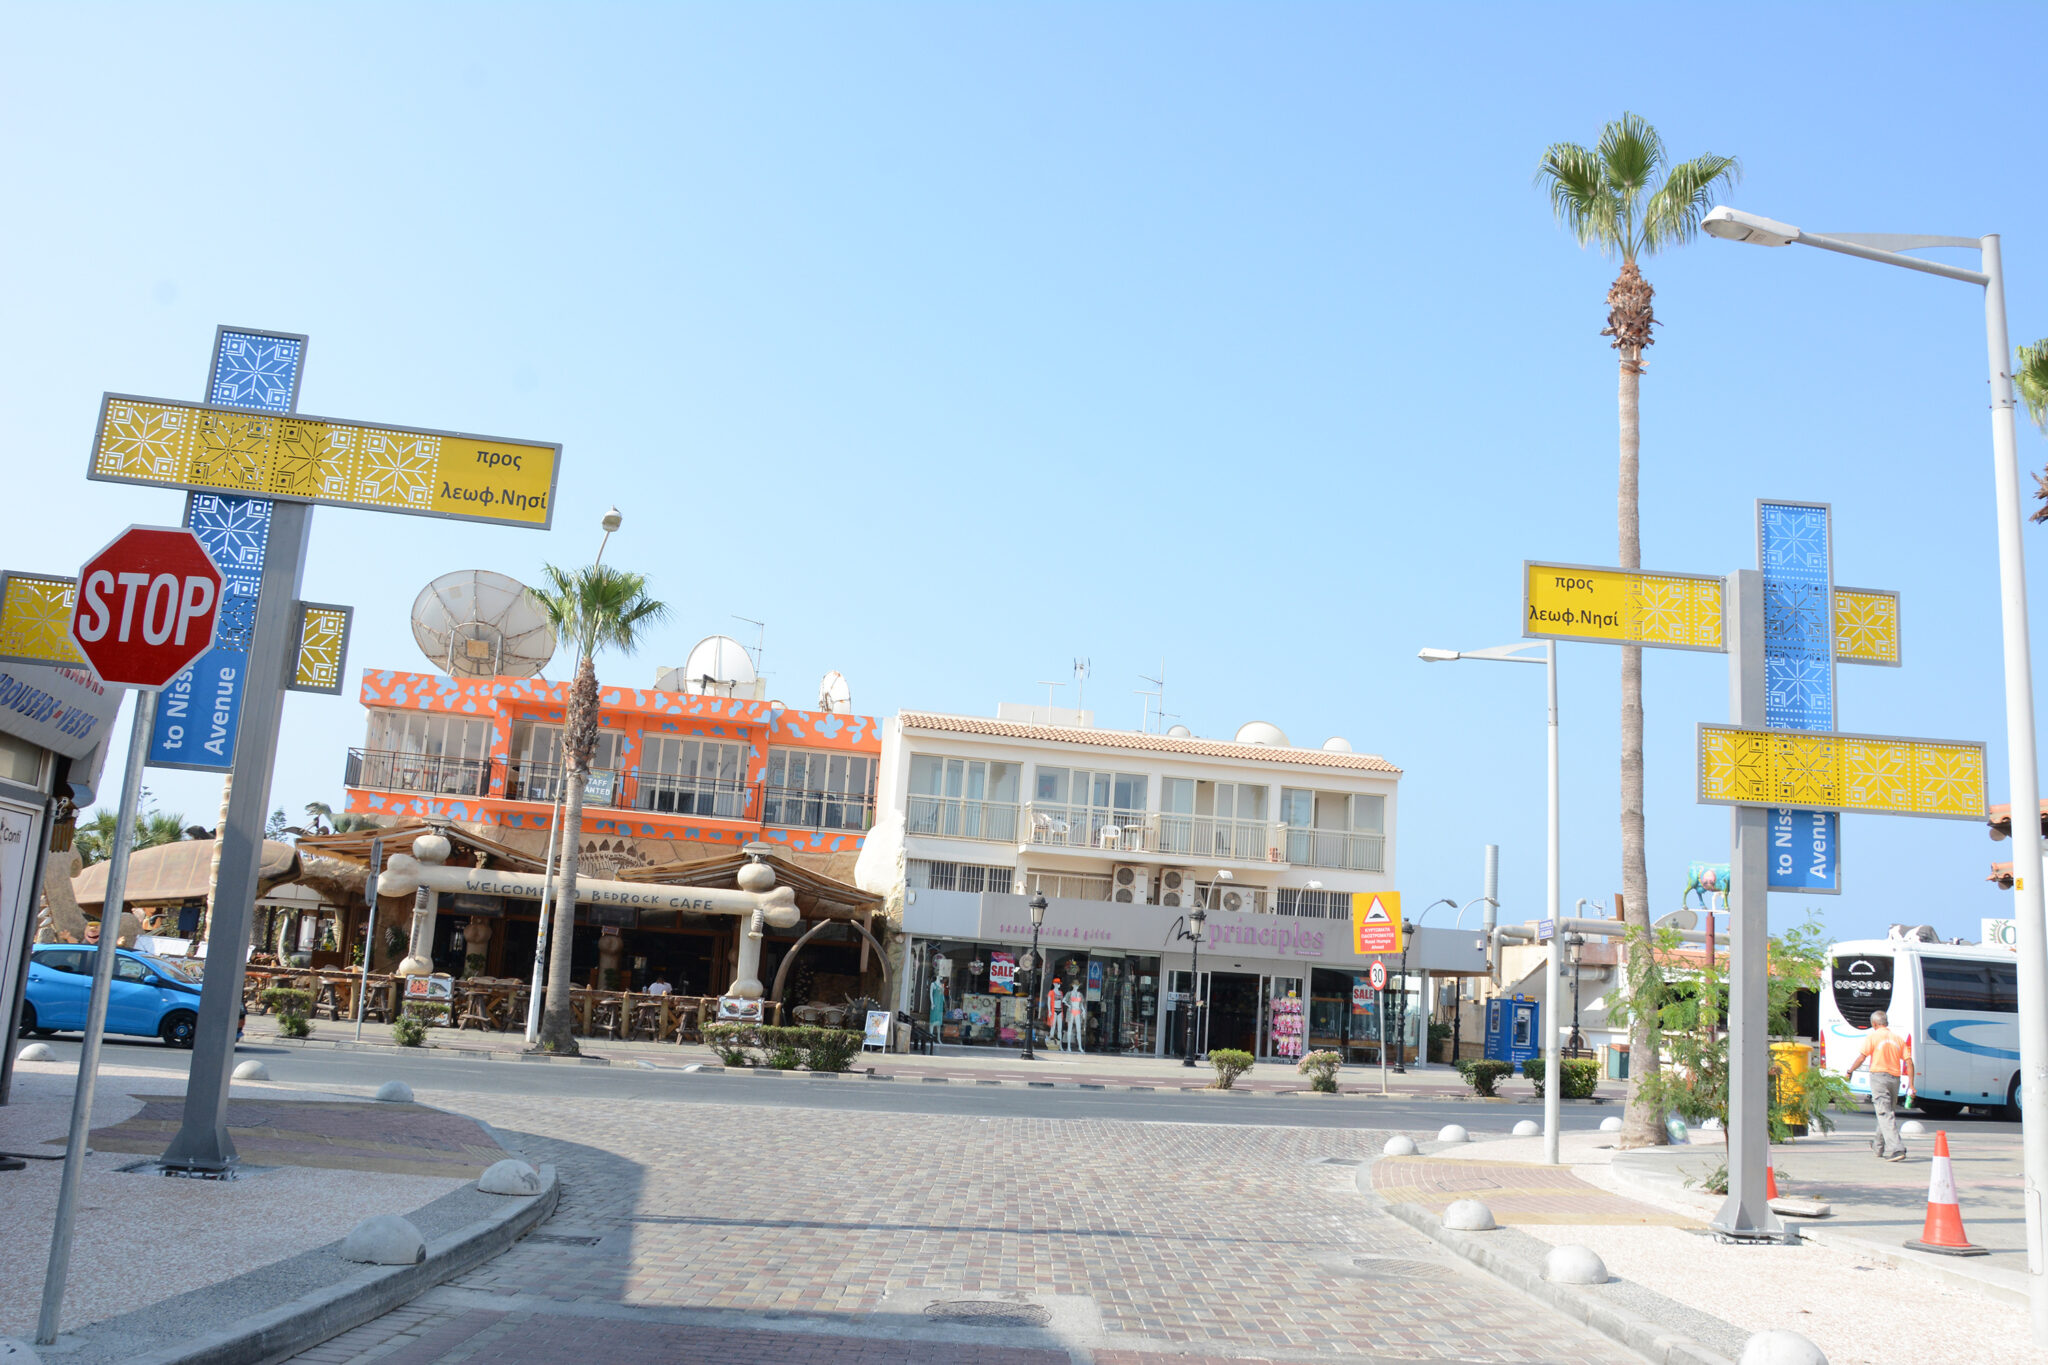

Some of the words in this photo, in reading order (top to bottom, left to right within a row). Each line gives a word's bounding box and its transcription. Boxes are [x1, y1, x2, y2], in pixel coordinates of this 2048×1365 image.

[476, 451, 522, 471] προς
[440, 481, 547, 511] λεωφ.Νησί
[1555, 577, 1594, 593] προς
[78, 569, 215, 646] STOP
[1529, 605, 1619, 629] λεωφ.Νησί
[167, 665, 194, 718] Niss
[204, 667, 236, 756] Avenue
[163, 726, 184, 750] to
[584, 786, 611, 796] ANTED
[588, 777, 608, 787] TAFF
[1775, 808, 1792, 847] Niss
[1810, 810, 1826, 879] Avenu
[1776, 854, 1792, 876] to
[592, 890, 660, 904] BEDROCK
[669, 898, 713, 911] CAFE
[1208, 916, 1325, 955] principles
[991, 964, 1014, 977] SALE
[1372, 968, 1383, 983] 30
[1353, 988, 1374, 1000] SALE
